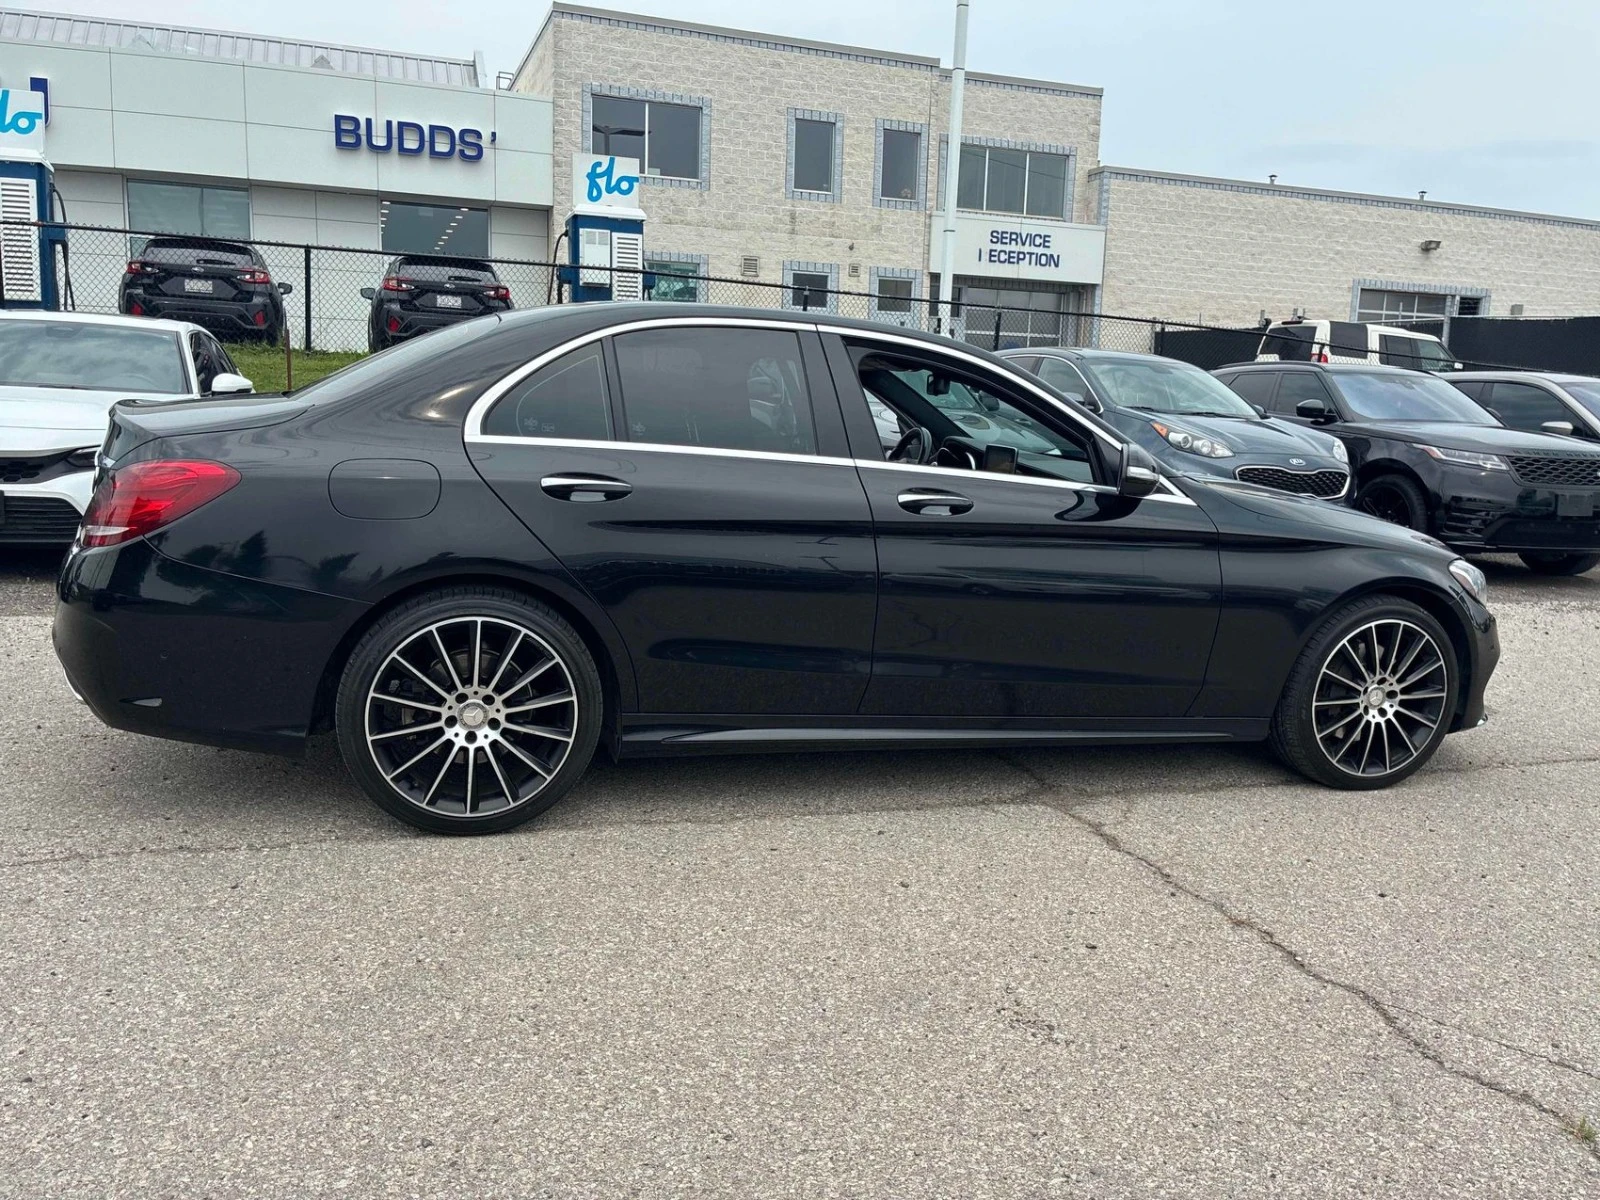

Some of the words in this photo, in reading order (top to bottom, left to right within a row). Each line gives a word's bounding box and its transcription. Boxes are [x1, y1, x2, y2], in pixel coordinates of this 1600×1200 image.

[0, 89, 43, 135] lo
[586, 156, 640, 203] flo
[990, 230, 1051, 249] SERVICE
